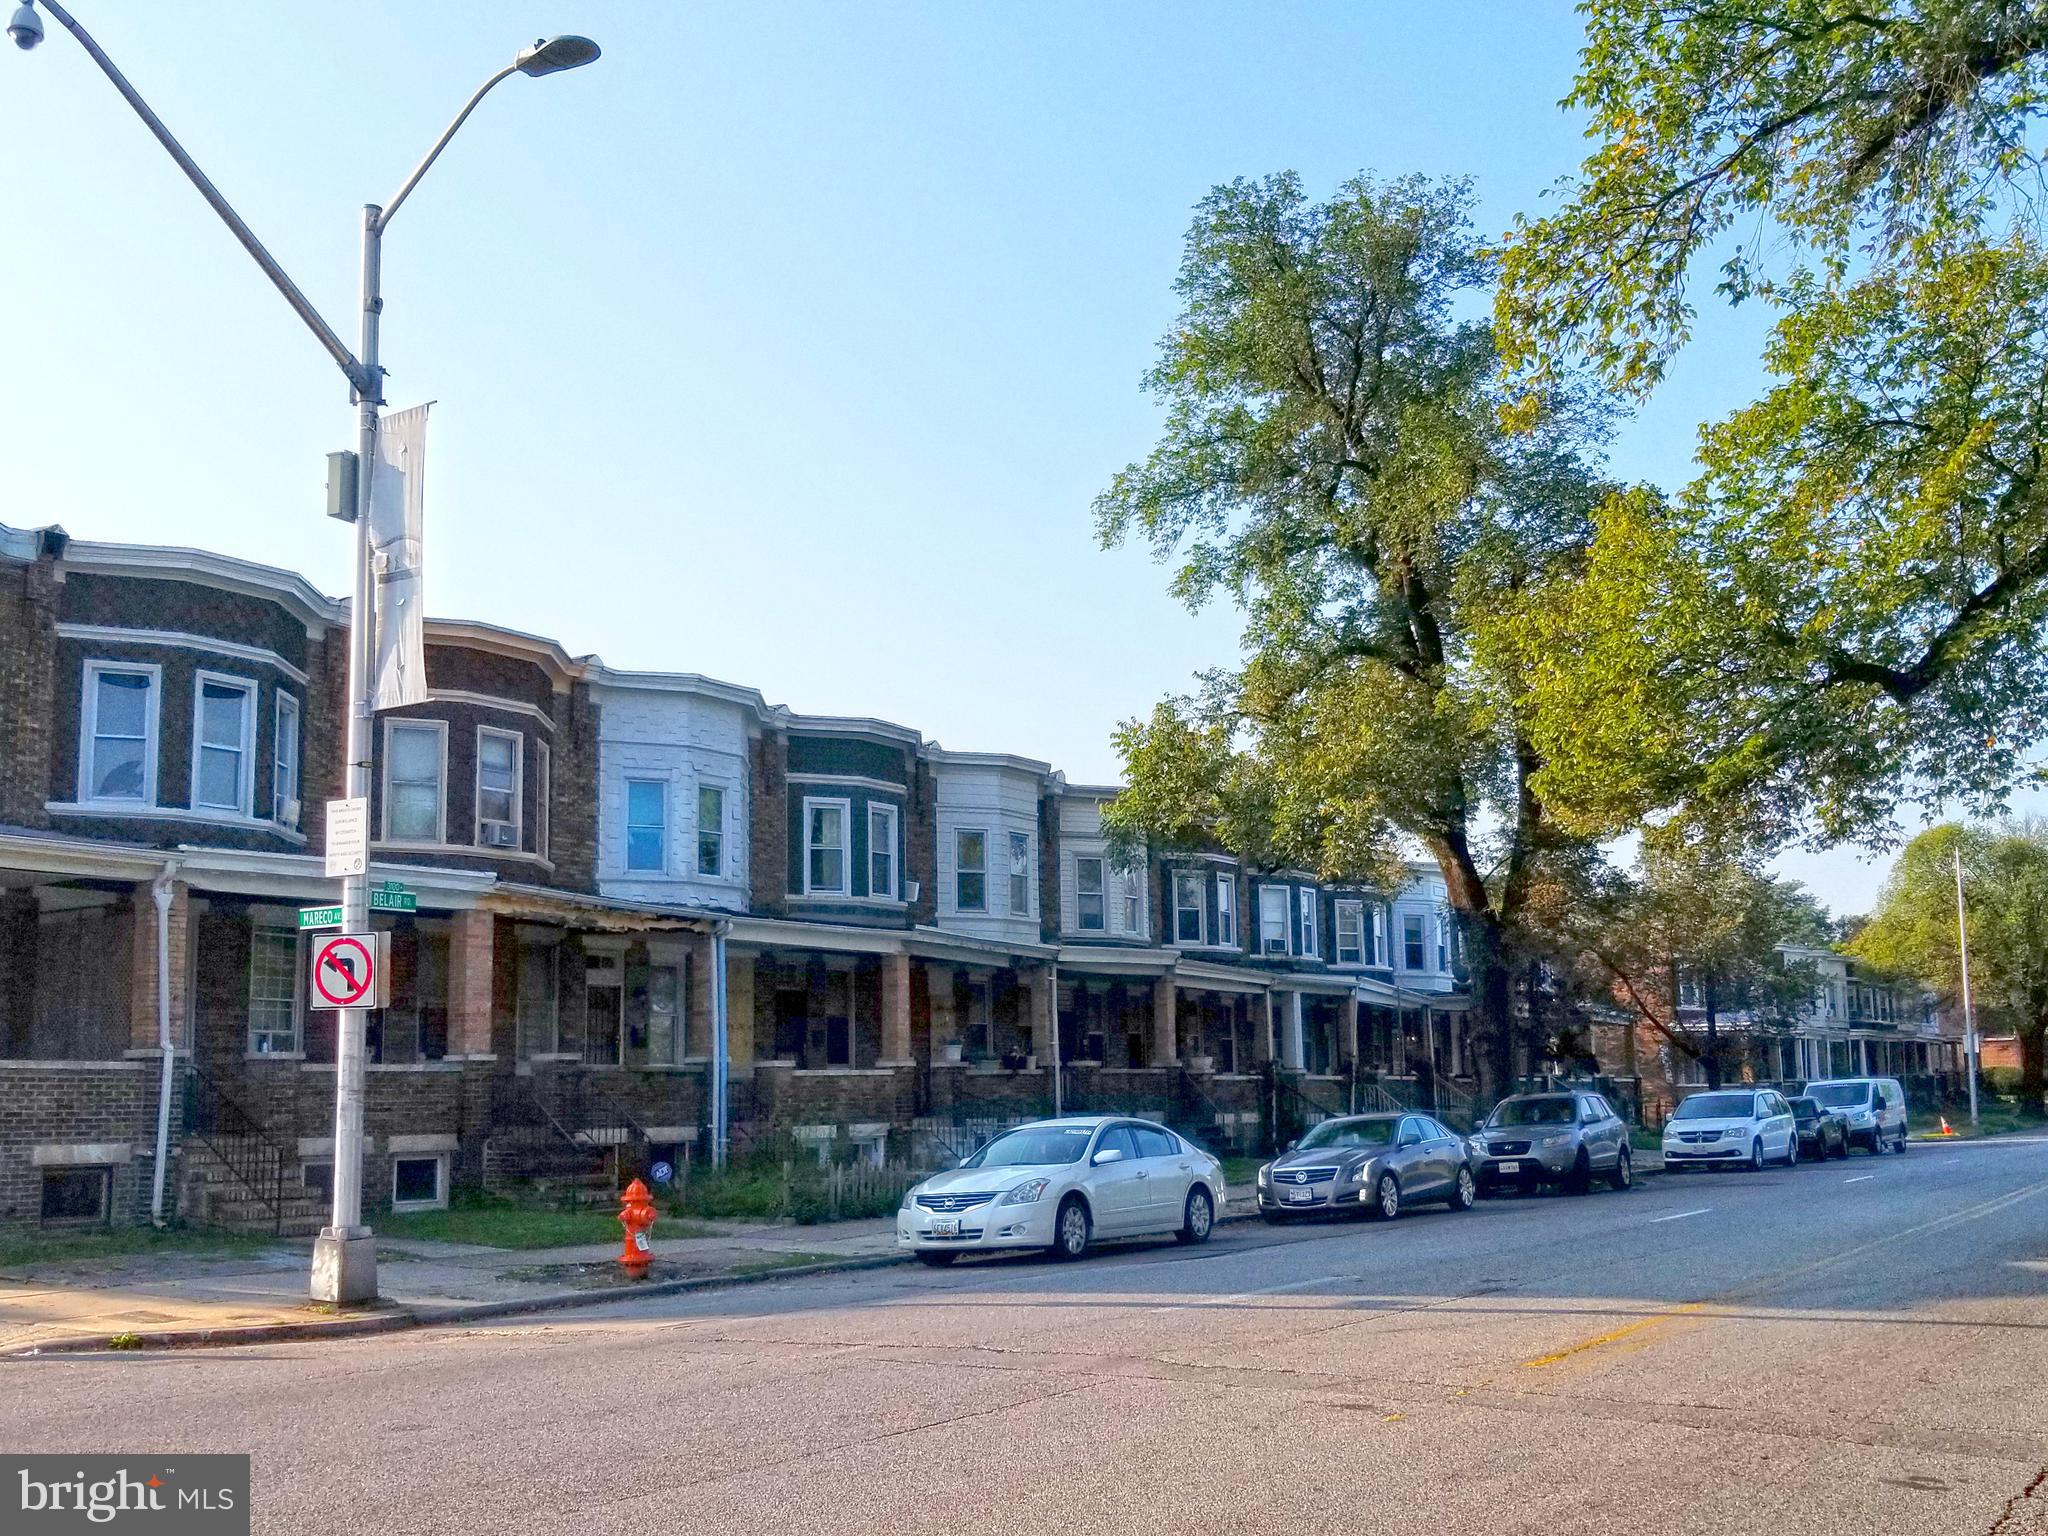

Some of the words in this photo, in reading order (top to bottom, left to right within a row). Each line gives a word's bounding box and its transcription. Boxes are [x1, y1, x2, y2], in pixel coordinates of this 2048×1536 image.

[373, 893, 402, 908] BELAIR
[303, 910, 333, 925] MARECO
[656, 1165, 668, 1178] ADT
